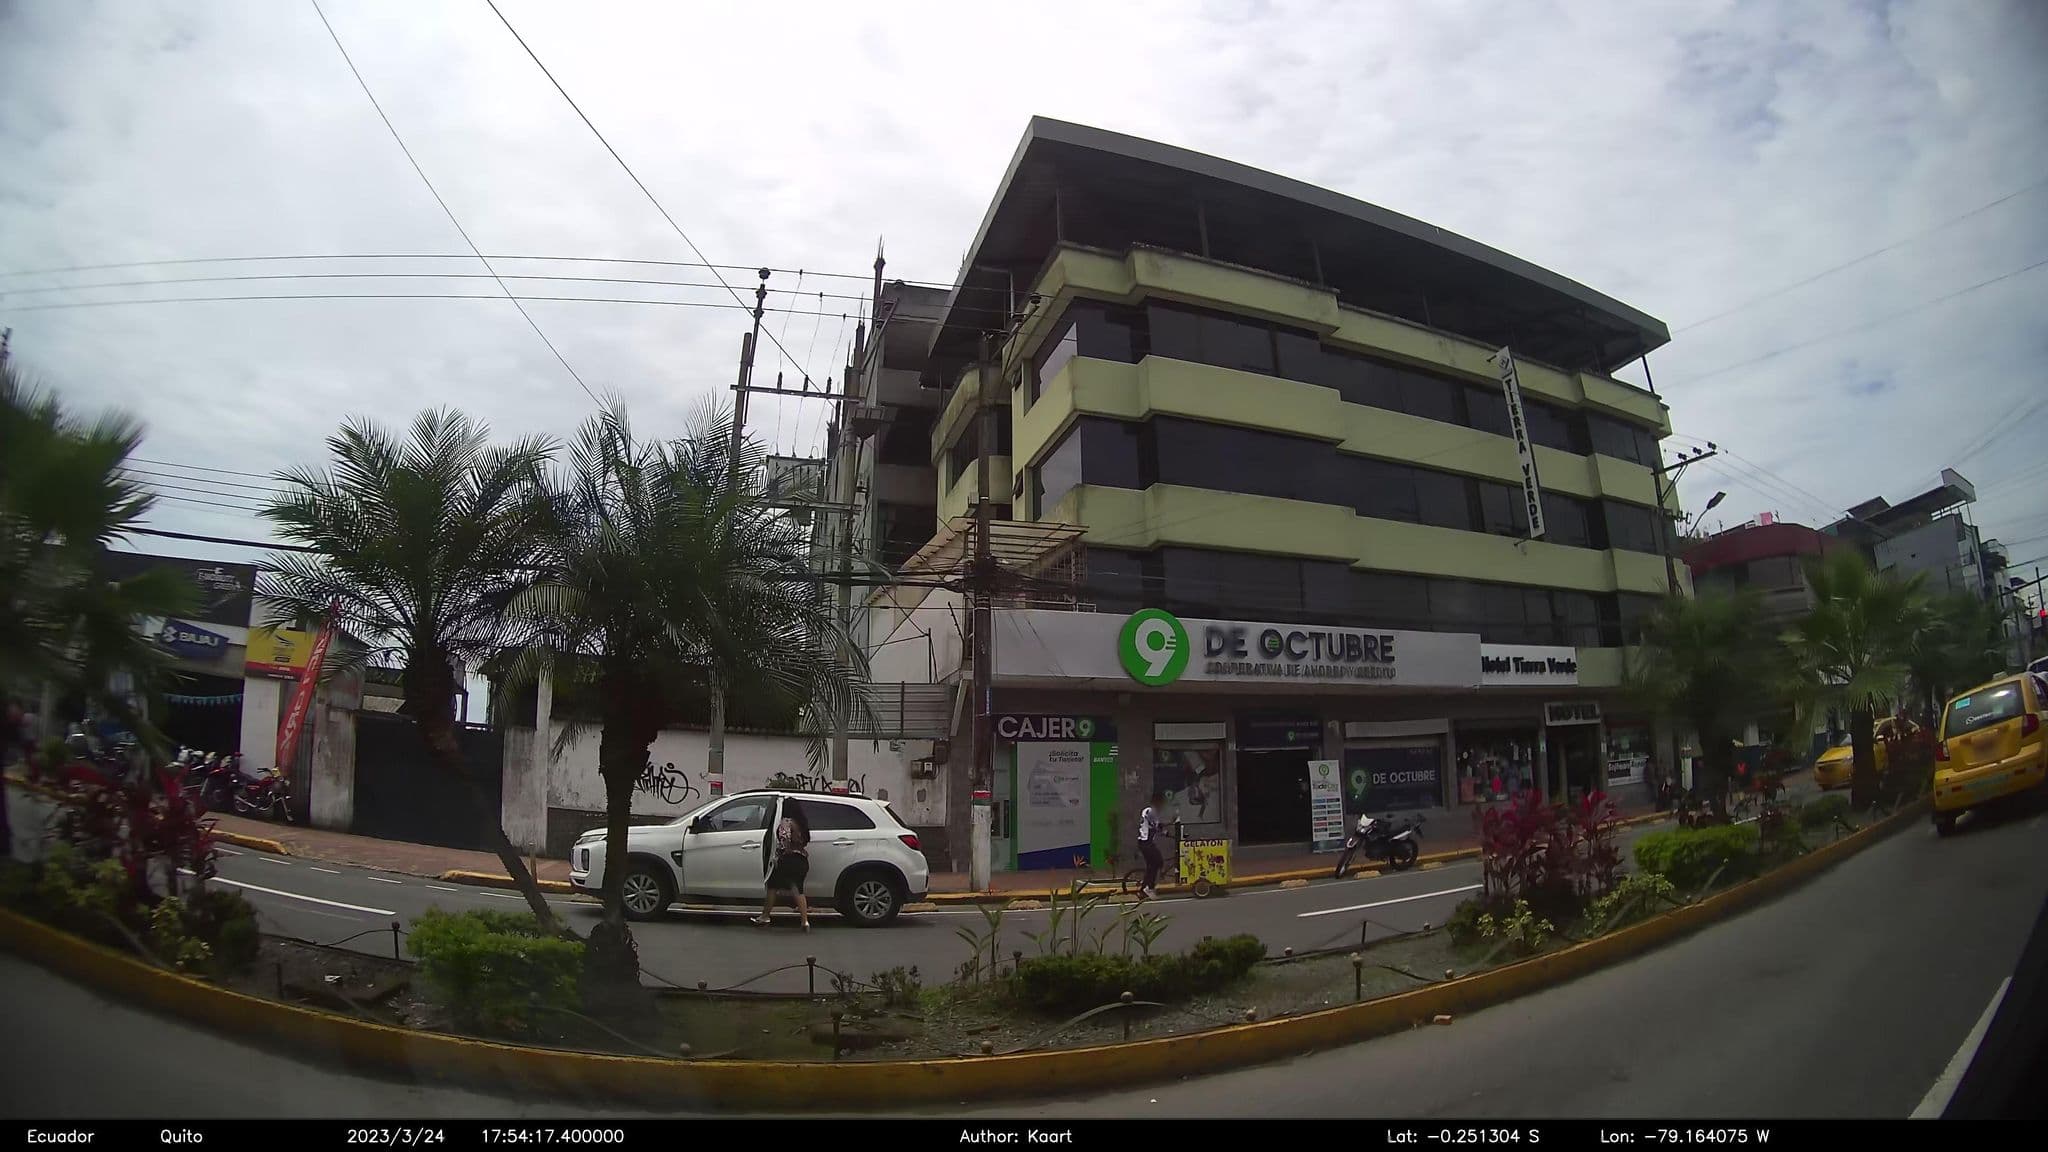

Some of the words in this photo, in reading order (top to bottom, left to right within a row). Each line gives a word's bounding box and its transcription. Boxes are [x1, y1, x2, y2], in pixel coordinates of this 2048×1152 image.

[1504, 378, 1527, 455] TIERRA
[1521, 463, 1540, 530] VERDE
[1134, 618, 1177, 677] 9
[1204, 625, 1248, 657] DE
[1260, 629, 1396, 663] OCTUBRE
[1481, 656, 1512, 674] Hotel
[1351, 769, 1367, 798] 9
[1372, 772, 1387, 785] DE
[1389, 770, 1436, 784] OCTUBRE
